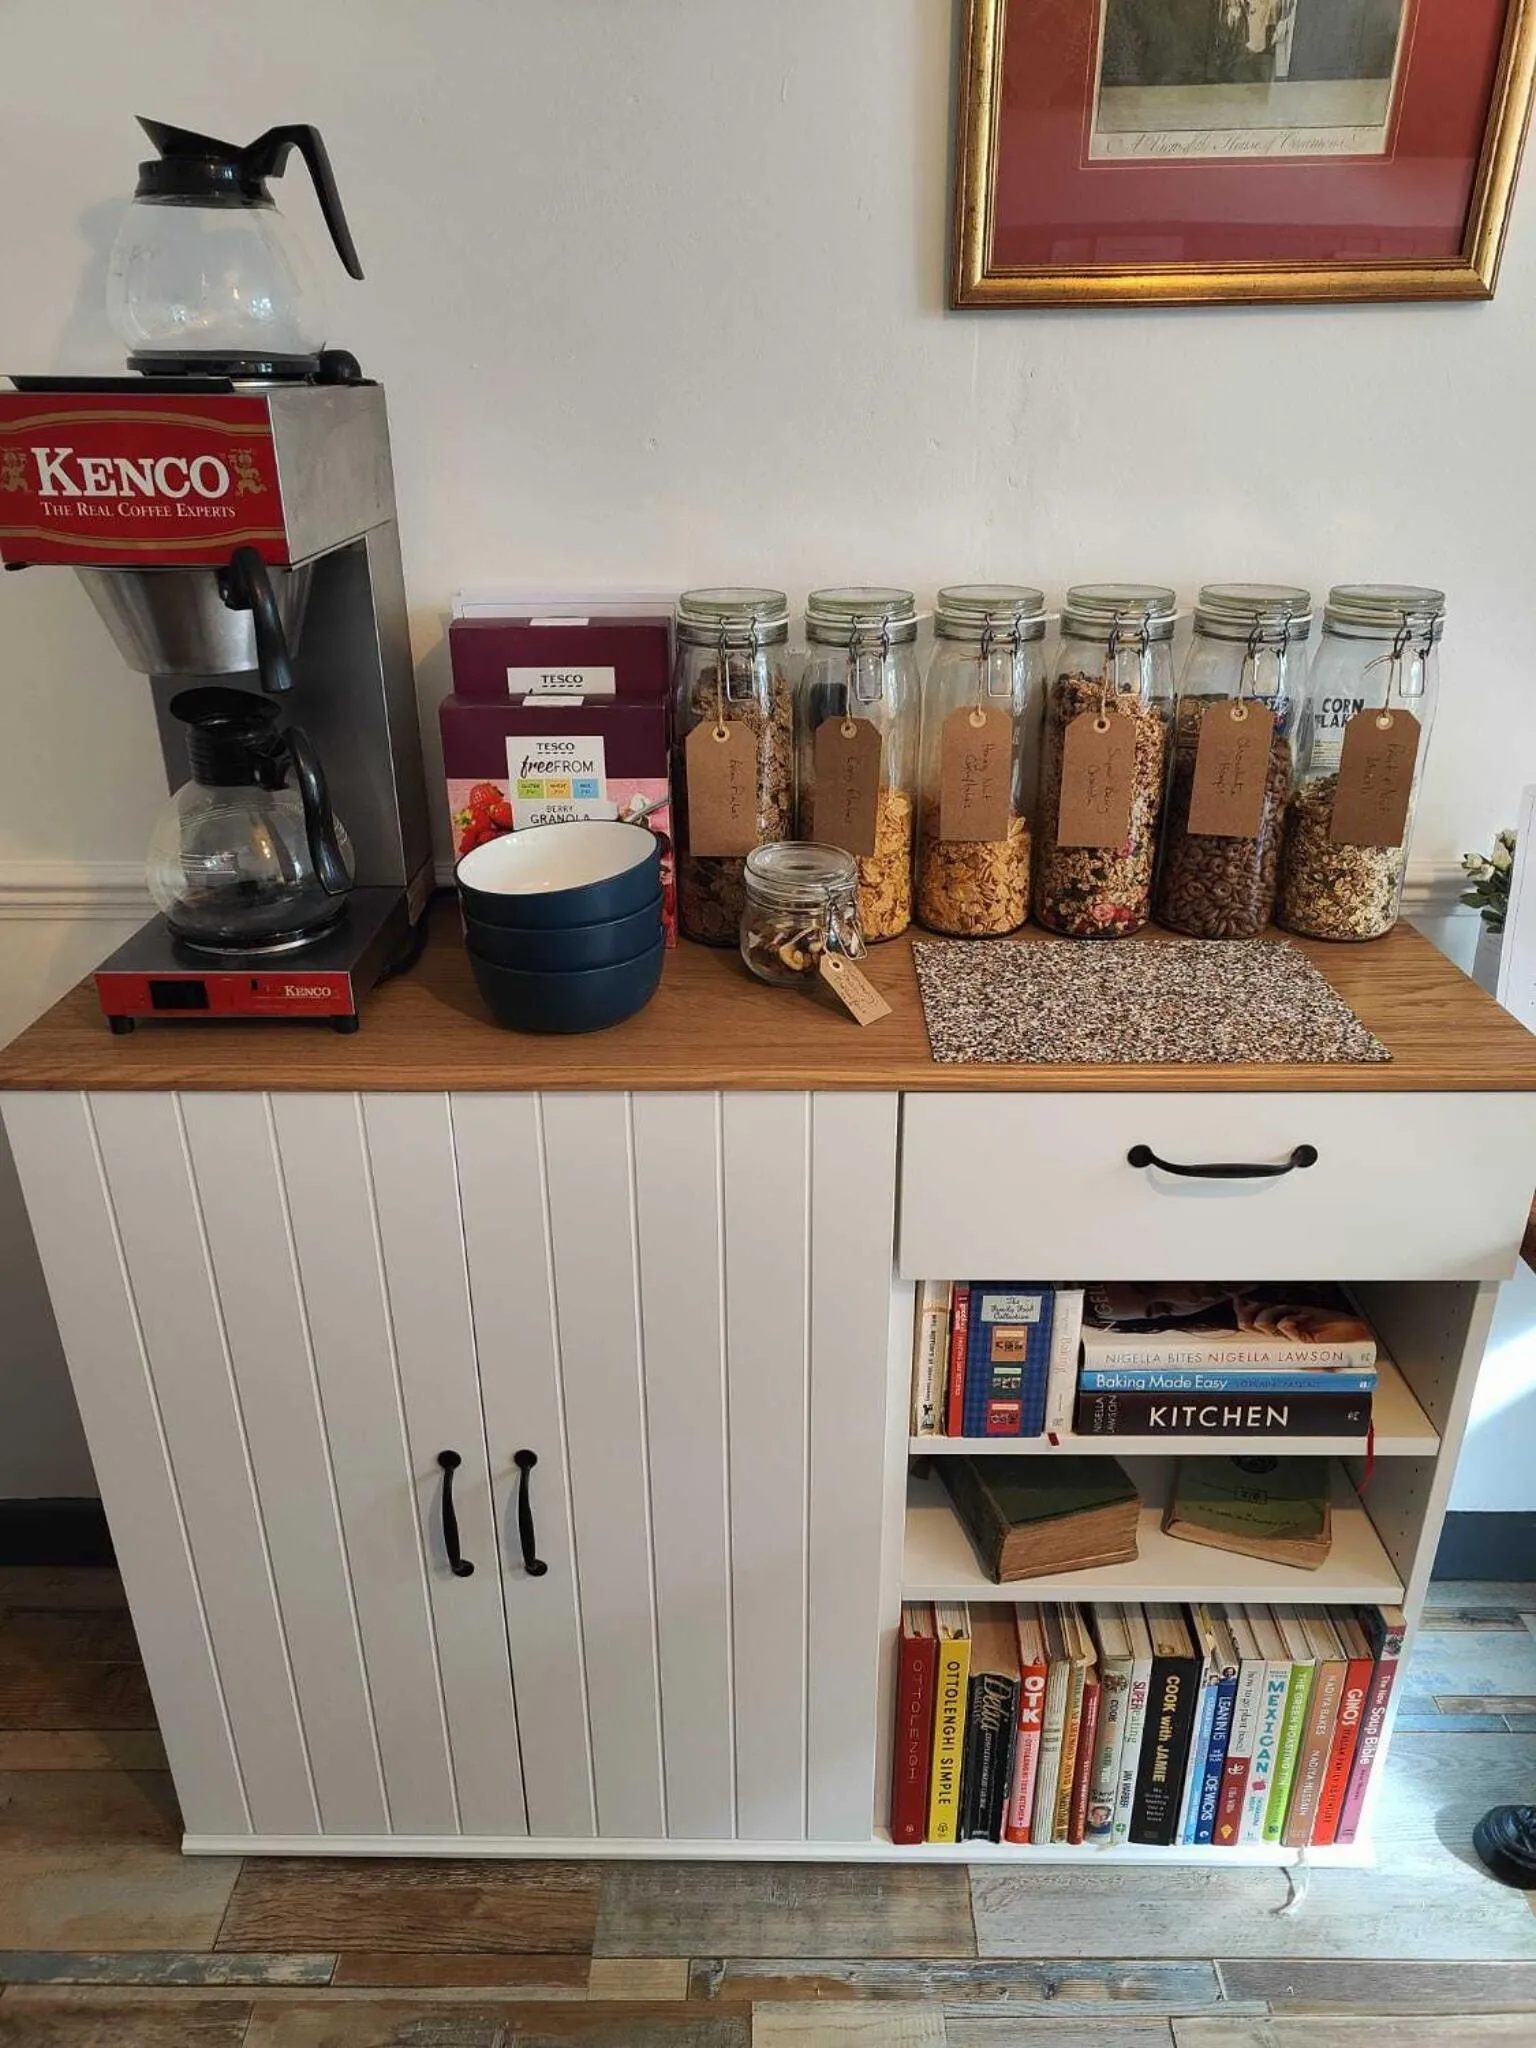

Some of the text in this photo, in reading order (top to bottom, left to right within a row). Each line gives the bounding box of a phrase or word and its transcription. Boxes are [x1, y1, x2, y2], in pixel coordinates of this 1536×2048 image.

[31, 447, 230, 499] KENCO
[117, 502, 172, 518] COFFEE
[176, 502, 236, 518] EXPERTS
[541, 673, 583, 684] TESCO
[1322, 698, 1365, 714] CORN
[537, 742, 576, 751] TESCO
[530, 813, 591, 825] GRANOLA
[546, 804, 573, 813] BERRY
[284, 985, 332, 997] KENCO
[1105, 1351, 1343, 1364] NIGELLA BITES NIGELLA LAWSON
[1096, 1373, 1228, 1390] Baking Made Easy
[1093, 1395, 1105, 1433] NIGELLA
[1149, 1405, 1290, 1428] KITCHEN
[1296, 1673, 1307, 1690] THE
[1380, 1674, 1391, 1690] The
[980, 1676, 1014, 1732] Delia
[1022, 1675, 1046, 1723] OTK
[1108, 1699, 1119, 1722] COOK
[1290, 1692, 1304, 1719] GREEN
[1315, 1674, 1337, 1736] NADIYA BAKES
[1342, 1688, 1364, 1726] GINO'S
[907, 1660, 923, 1784] OTTOLENGHI
[1152, 1675, 1181, 1783] COOK with JAMIE
[1213, 1696, 1232, 1741] LEAN IN 15
[1239, 1707, 1252, 1729] plant
[1256, 1680, 1285, 1773] MEXICAN
[1364, 1707, 1386, 1735] Soup
[938, 1661, 960, 1805] OTTOLENGHI SIMPLE
[1281, 1724, 1297, 1769] ROASTING
[1359, 1737, 1379, 1765] Bible
[1205, 1774, 1219, 1792] JOE
[1278, 1772, 1289, 1785] TIN
[1299, 1749, 1320, 1816] NADIYA HUSSAIN
[1201, 1790, 1217, 1821] WICKS
